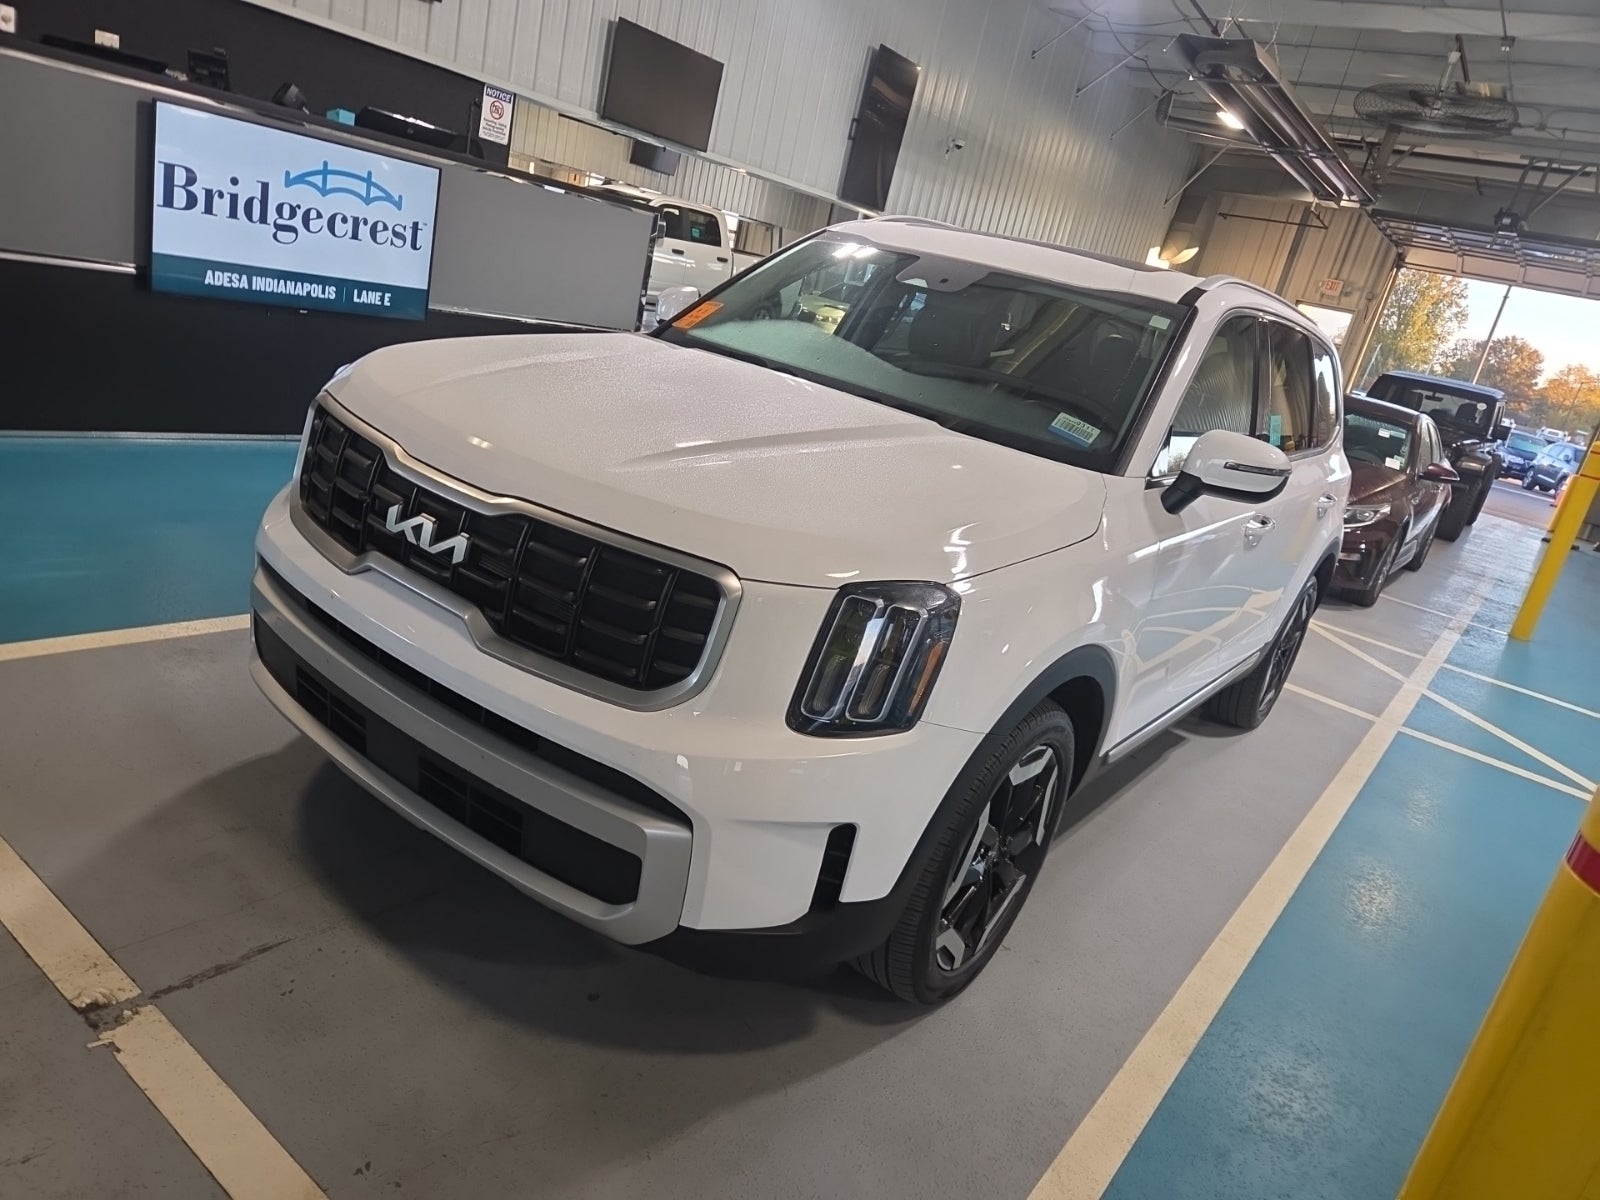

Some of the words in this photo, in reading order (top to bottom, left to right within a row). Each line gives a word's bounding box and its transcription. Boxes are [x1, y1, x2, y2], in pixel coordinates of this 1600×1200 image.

[486, 87, 511, 102] NOTICE
[156, 160, 423, 251] Bridgecrest
[204, 269, 249, 290] ADESA
[251, 275, 337, 300] INDIANAPOLIS
[353, 288, 382, 306] LANE
[383, 292, 392, 307] E
[385, 502, 470, 565] KIA
